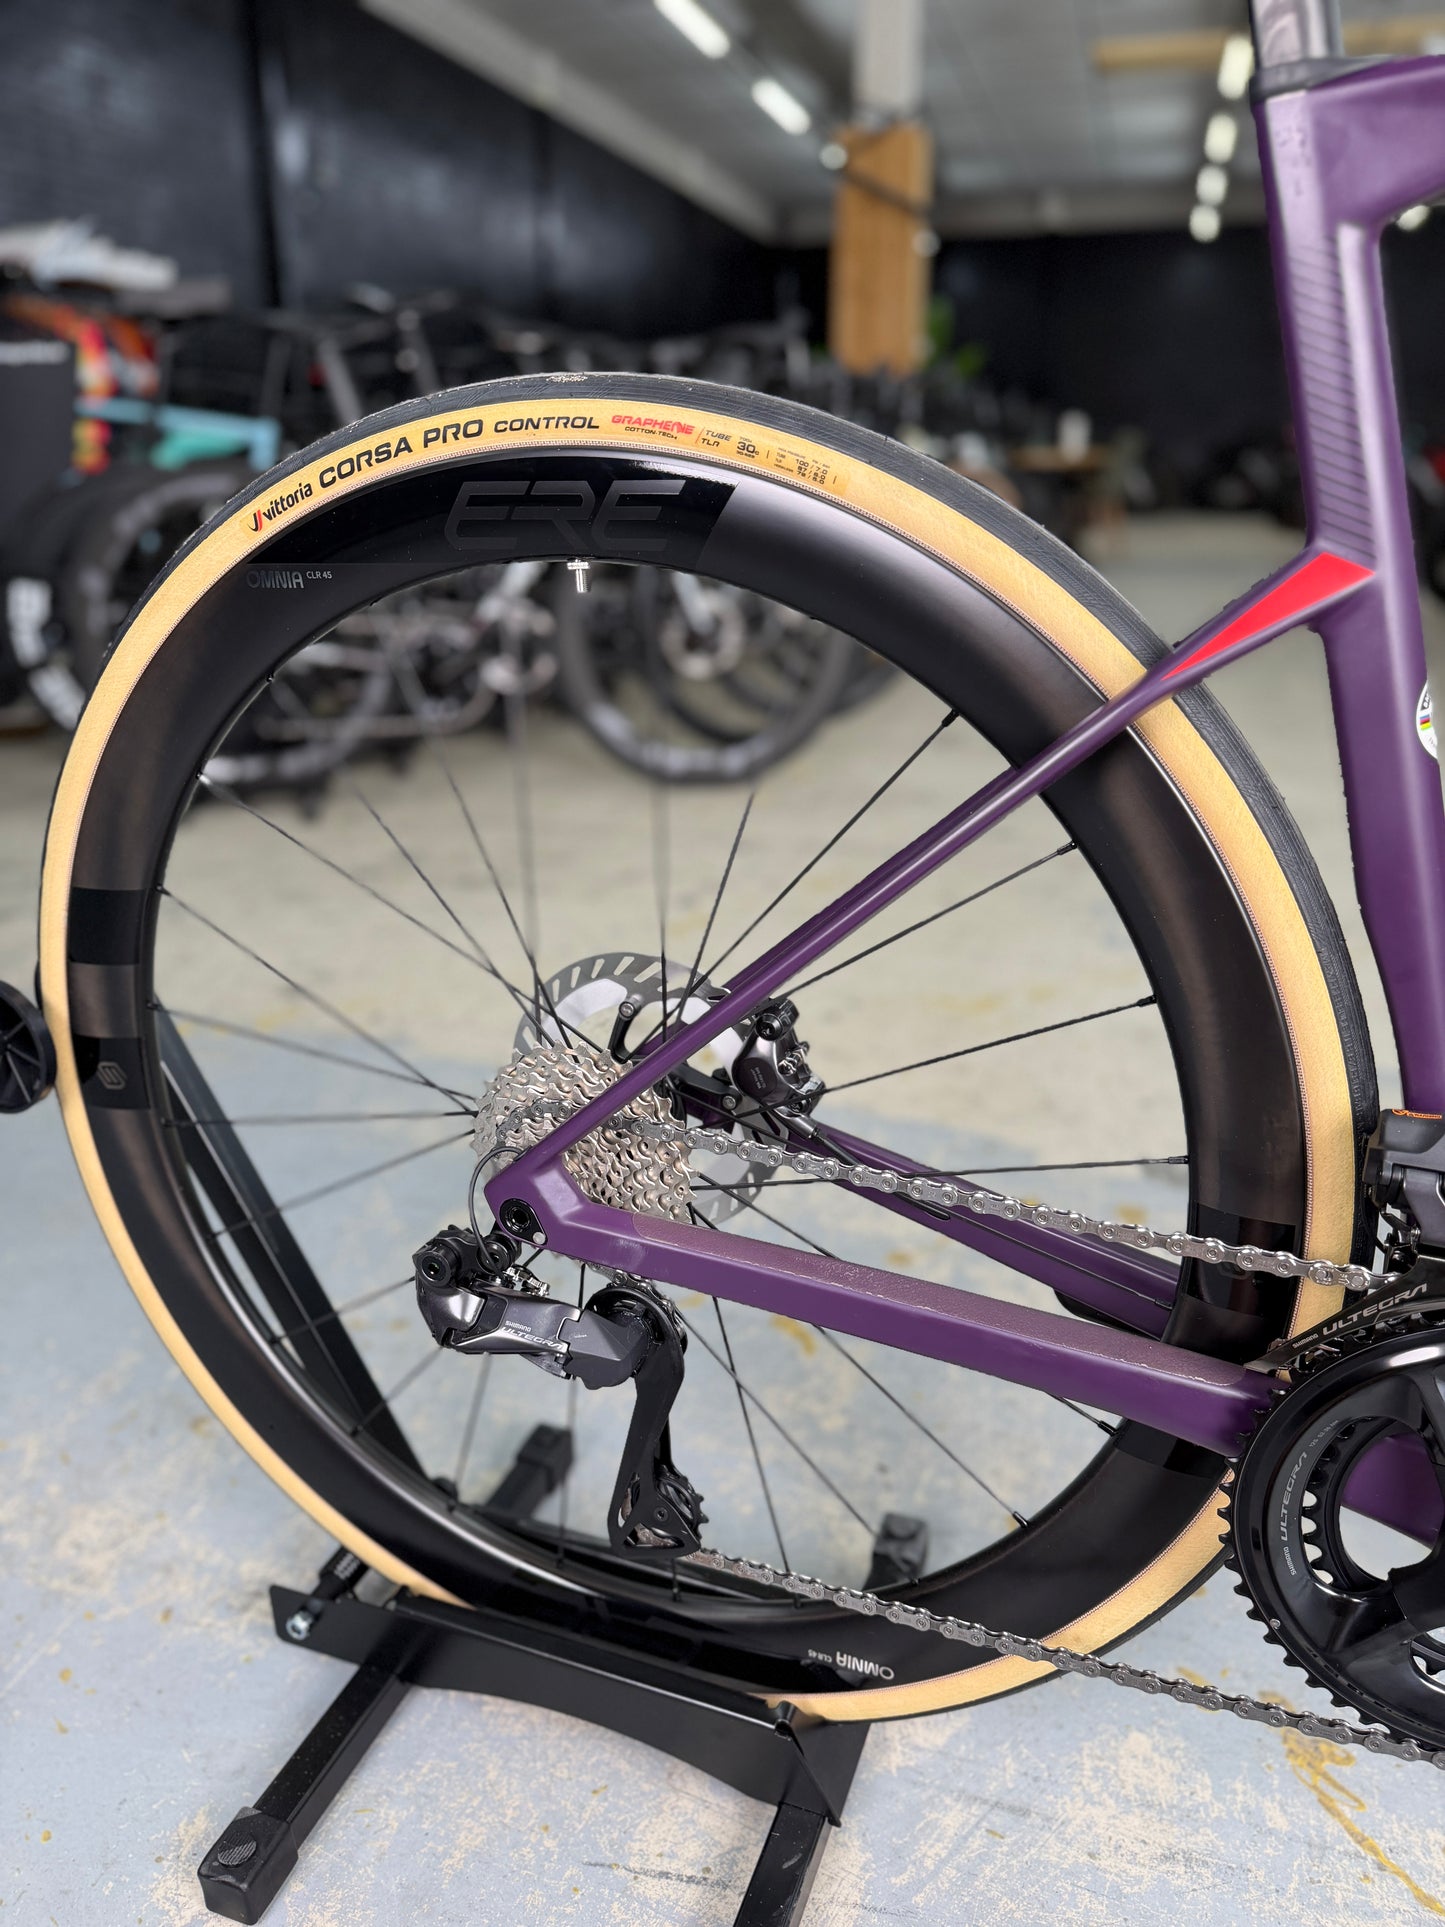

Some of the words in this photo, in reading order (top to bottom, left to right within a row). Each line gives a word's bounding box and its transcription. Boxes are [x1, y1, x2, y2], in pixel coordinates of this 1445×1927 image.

[701, 437, 720, 447] TLR
[705, 429, 732, 441] TUBE
[319, 436, 413, 489] CORSA
[423, 419, 484, 448] PRO
[494, 416, 600, 434] CONTROL
[611, 414, 696, 435] GRAPHENE
[796, 458, 810, 468] 100
[444, 480, 686, 550] ERE
[246, 570, 305, 589] OMNIA
[306, 570, 321, 579] CLR
[322, 570, 333, 579] 45
[504, 1320, 532, 1333] SHIMANO
[1291, 1332, 1319, 1349] SHIMANO
[1322, 1283, 1428, 1336] ULTEGRA
[501, 1326, 563, 1350] ULTEGRA
[1280, 1451, 1308, 1541] ULTEGRA
[1283, 1546, 1297, 1576] SHIMANO
[835, 1651, 895, 1680] OMNIA
